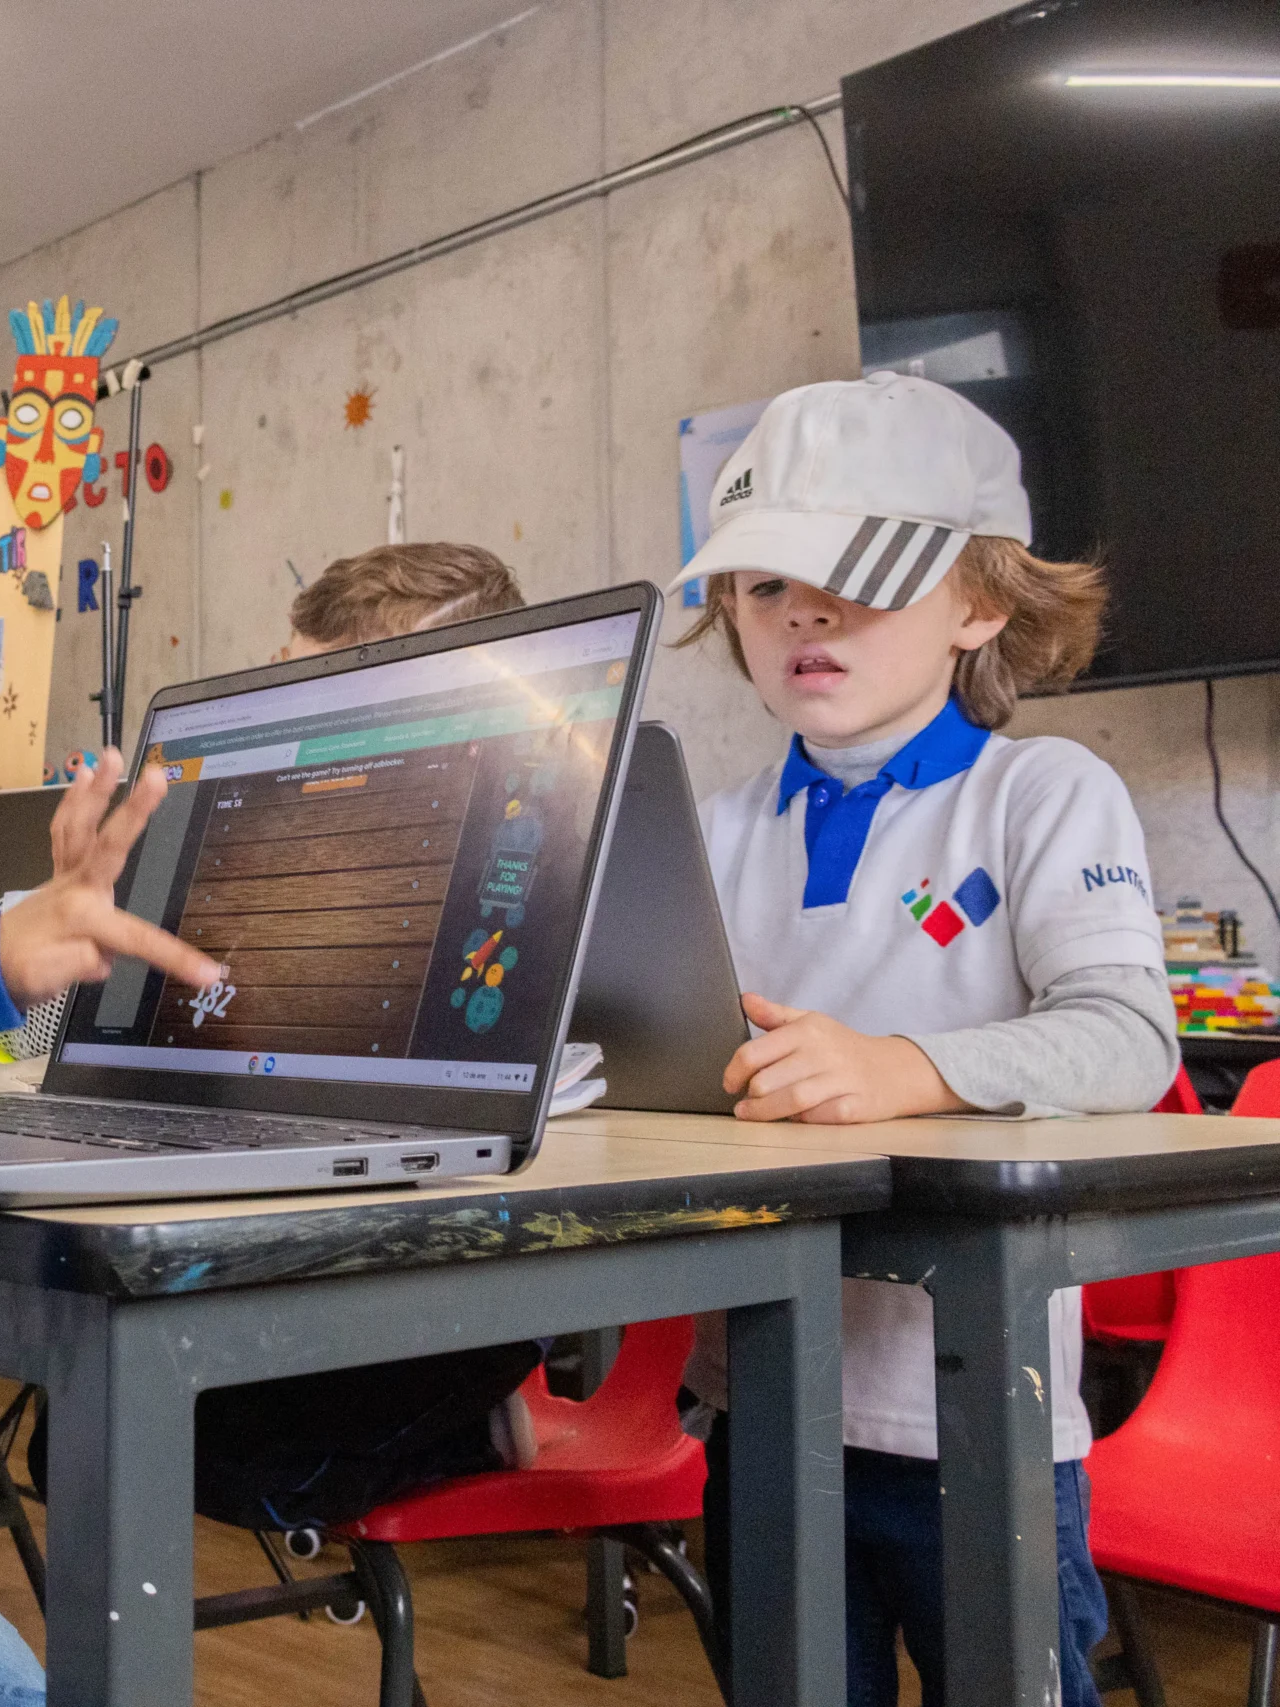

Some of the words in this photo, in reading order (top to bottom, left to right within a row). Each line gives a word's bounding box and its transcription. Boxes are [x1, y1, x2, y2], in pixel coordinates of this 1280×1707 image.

[720, 488, 753, 506] adidas
[276, 774, 291, 782] Can't
[311, 768, 331, 778] game?
[364, 762, 374, 770] off
[217, 800, 233, 809] TIME
[496, 859, 528, 871] THANKS
[500, 872, 517, 882] FOR
[487, 881, 523, 895] PLAYING!
